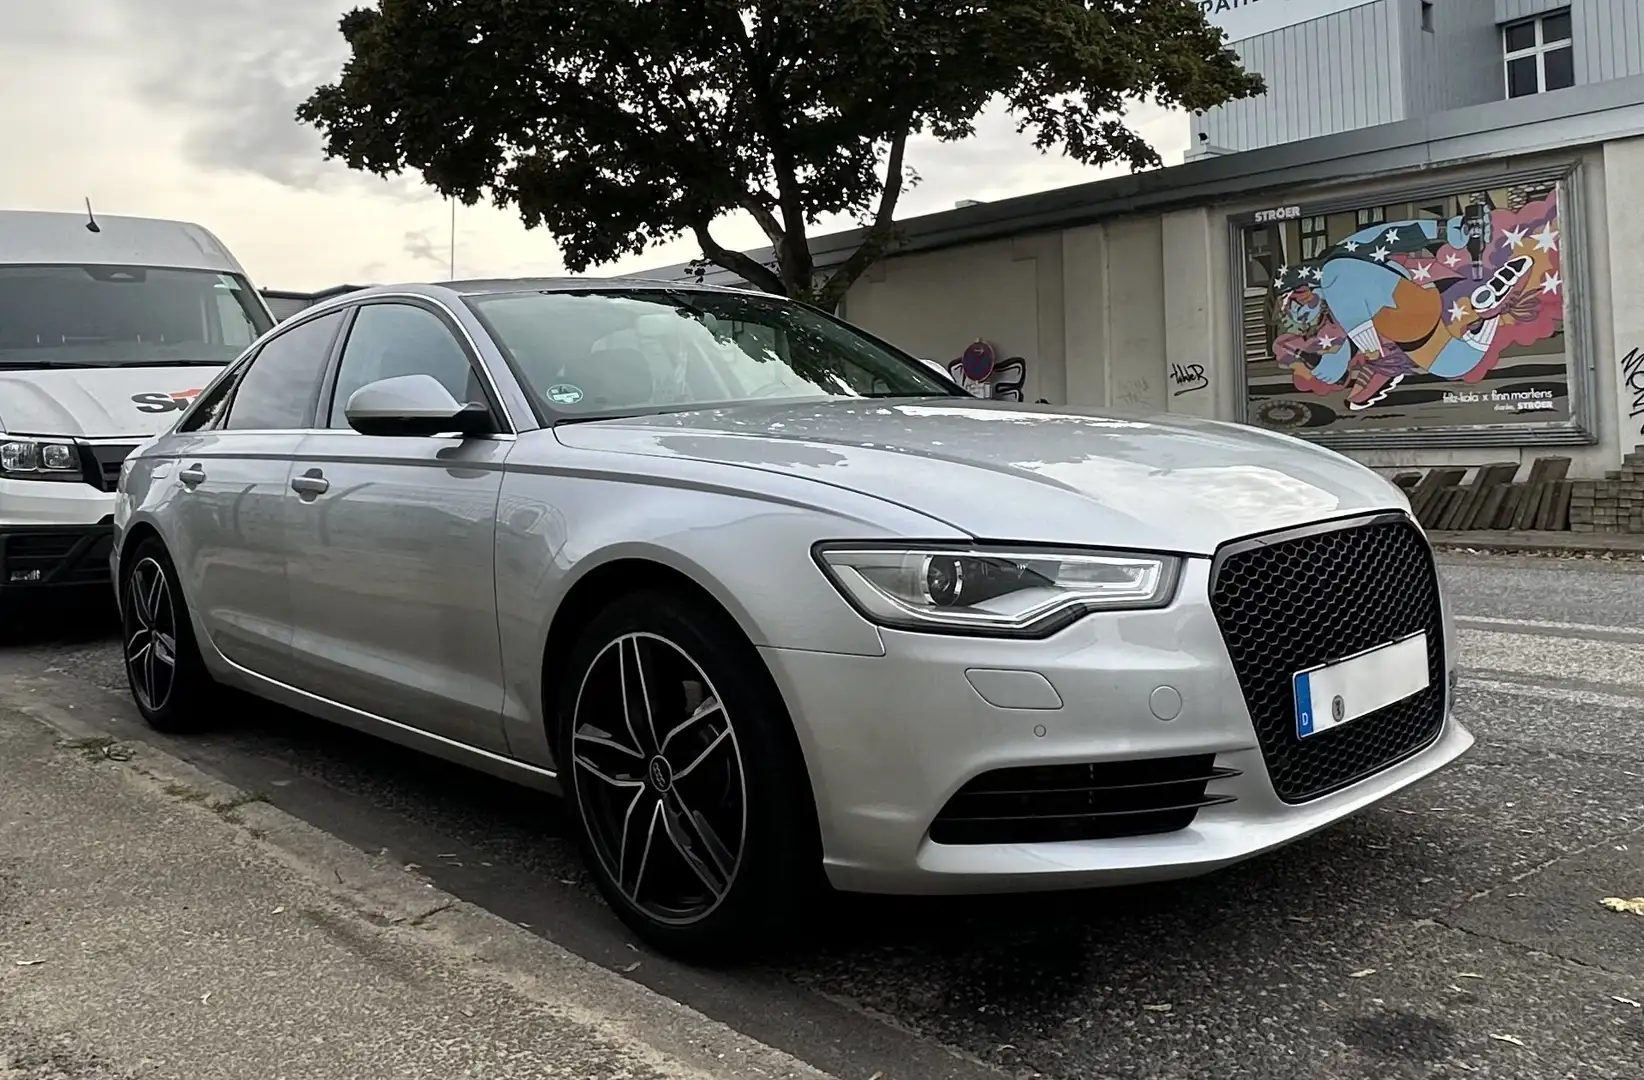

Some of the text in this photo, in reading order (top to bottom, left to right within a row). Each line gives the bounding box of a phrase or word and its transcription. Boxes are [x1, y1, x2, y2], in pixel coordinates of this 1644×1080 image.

[1482, 393, 1490, 402] x
[1491, 389, 1511, 401] finn
[1511, 388, 1553, 400] martens
[1302, 712, 1309, 726] D
